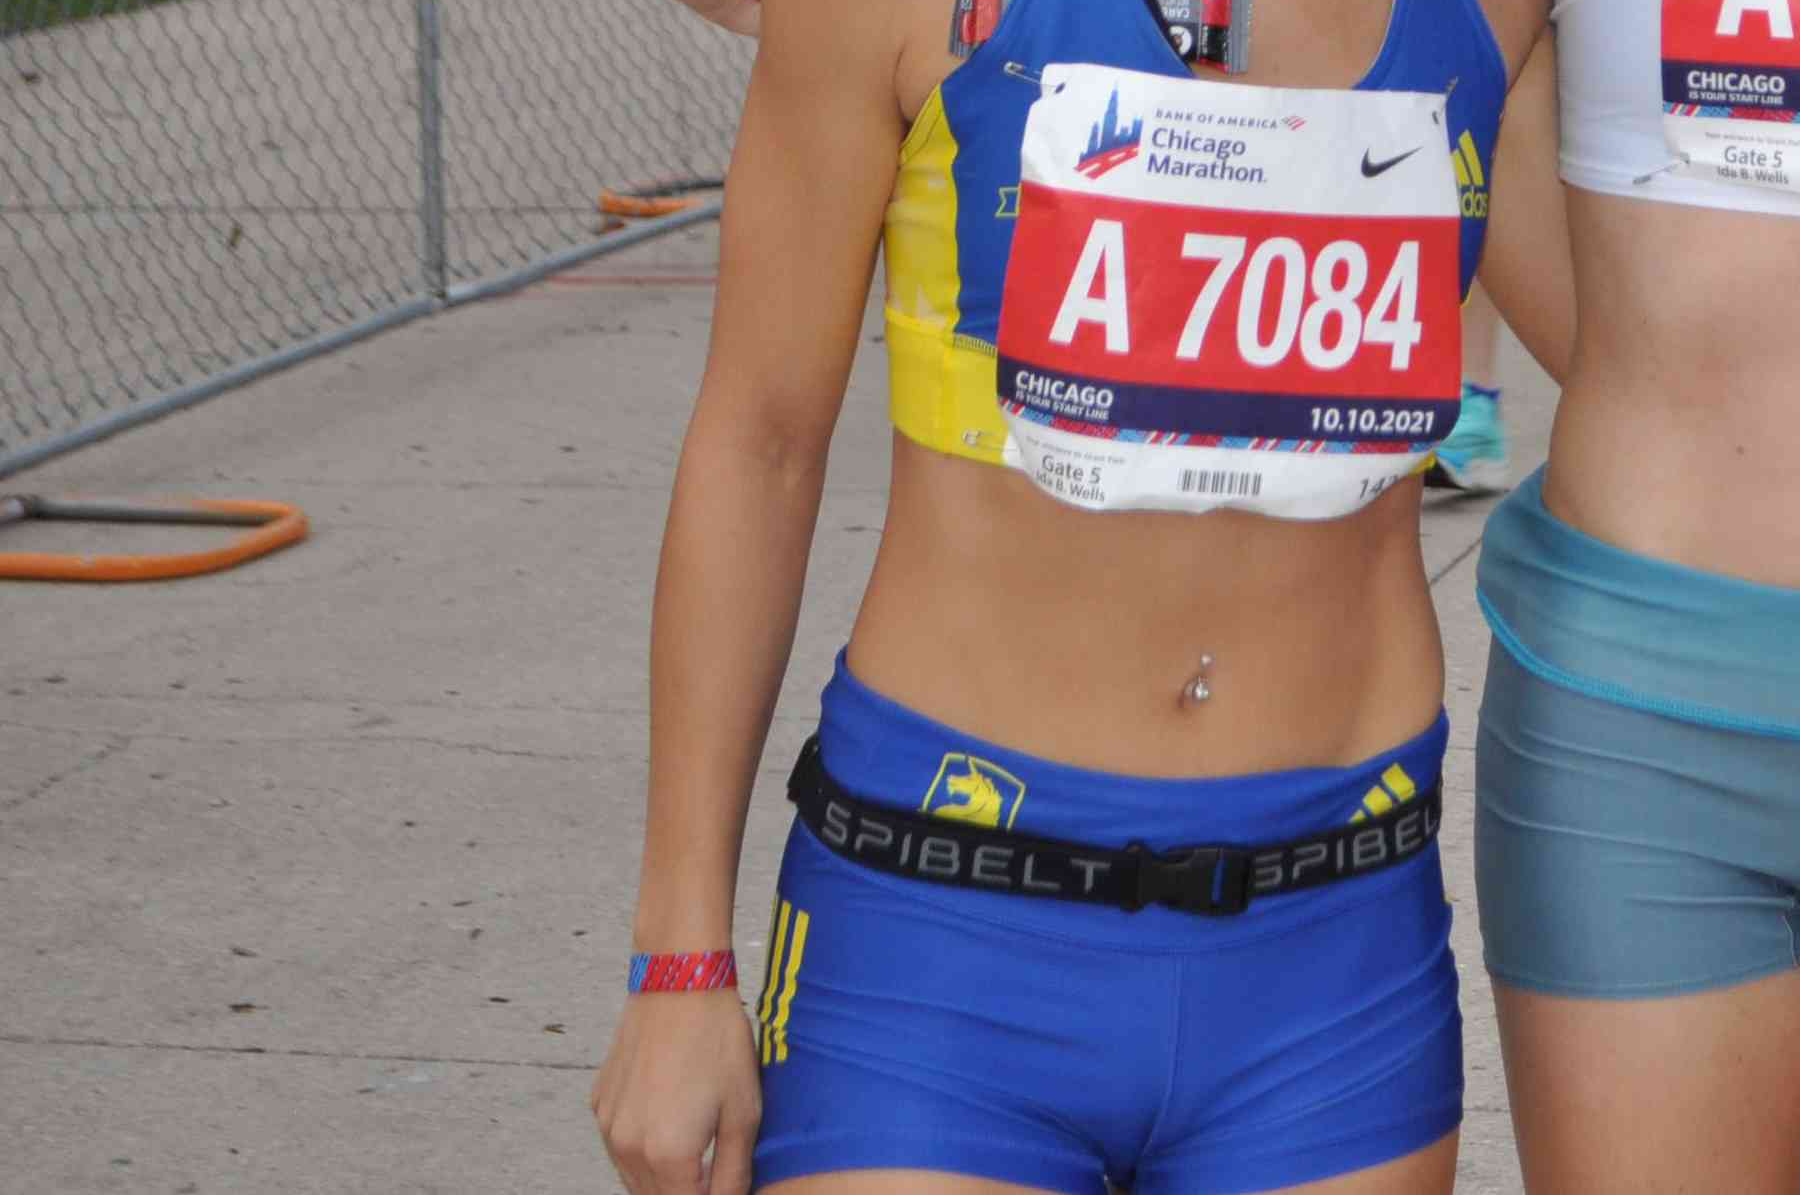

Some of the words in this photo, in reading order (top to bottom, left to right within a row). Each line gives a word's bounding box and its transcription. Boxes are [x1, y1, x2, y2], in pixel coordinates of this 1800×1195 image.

[1687, 69, 1786, 95] CHICAGO
[1728, 93, 1760, 104] START
[1156, 108, 1193, 122] BANK
[1197, 112, 1215, 124] OF
[1217, 116, 1278, 130] AMERICA
[1151, 127, 1247, 161] Chicago
[1723, 145, 1767, 167] Gate
[1773, 150, 1783, 168] 5
[1716, 165, 1738, 178] Ida
[1755, 169, 1789, 185] Wells
[1047, 218, 1131, 354] A
[1175, 232, 1423, 372] 7084
[1015, 369, 1114, 409] CHICAGO
[1311, 406, 1435, 434] 10.10.2021
[1042, 454, 1084, 483] Gate
[1089, 466, 1101, 486] 5
[1070, 483, 1106, 503] Wells
[820, 800, 1112, 895] SPIBELT
[1254, 806, 1440, 890] SPIBEL
